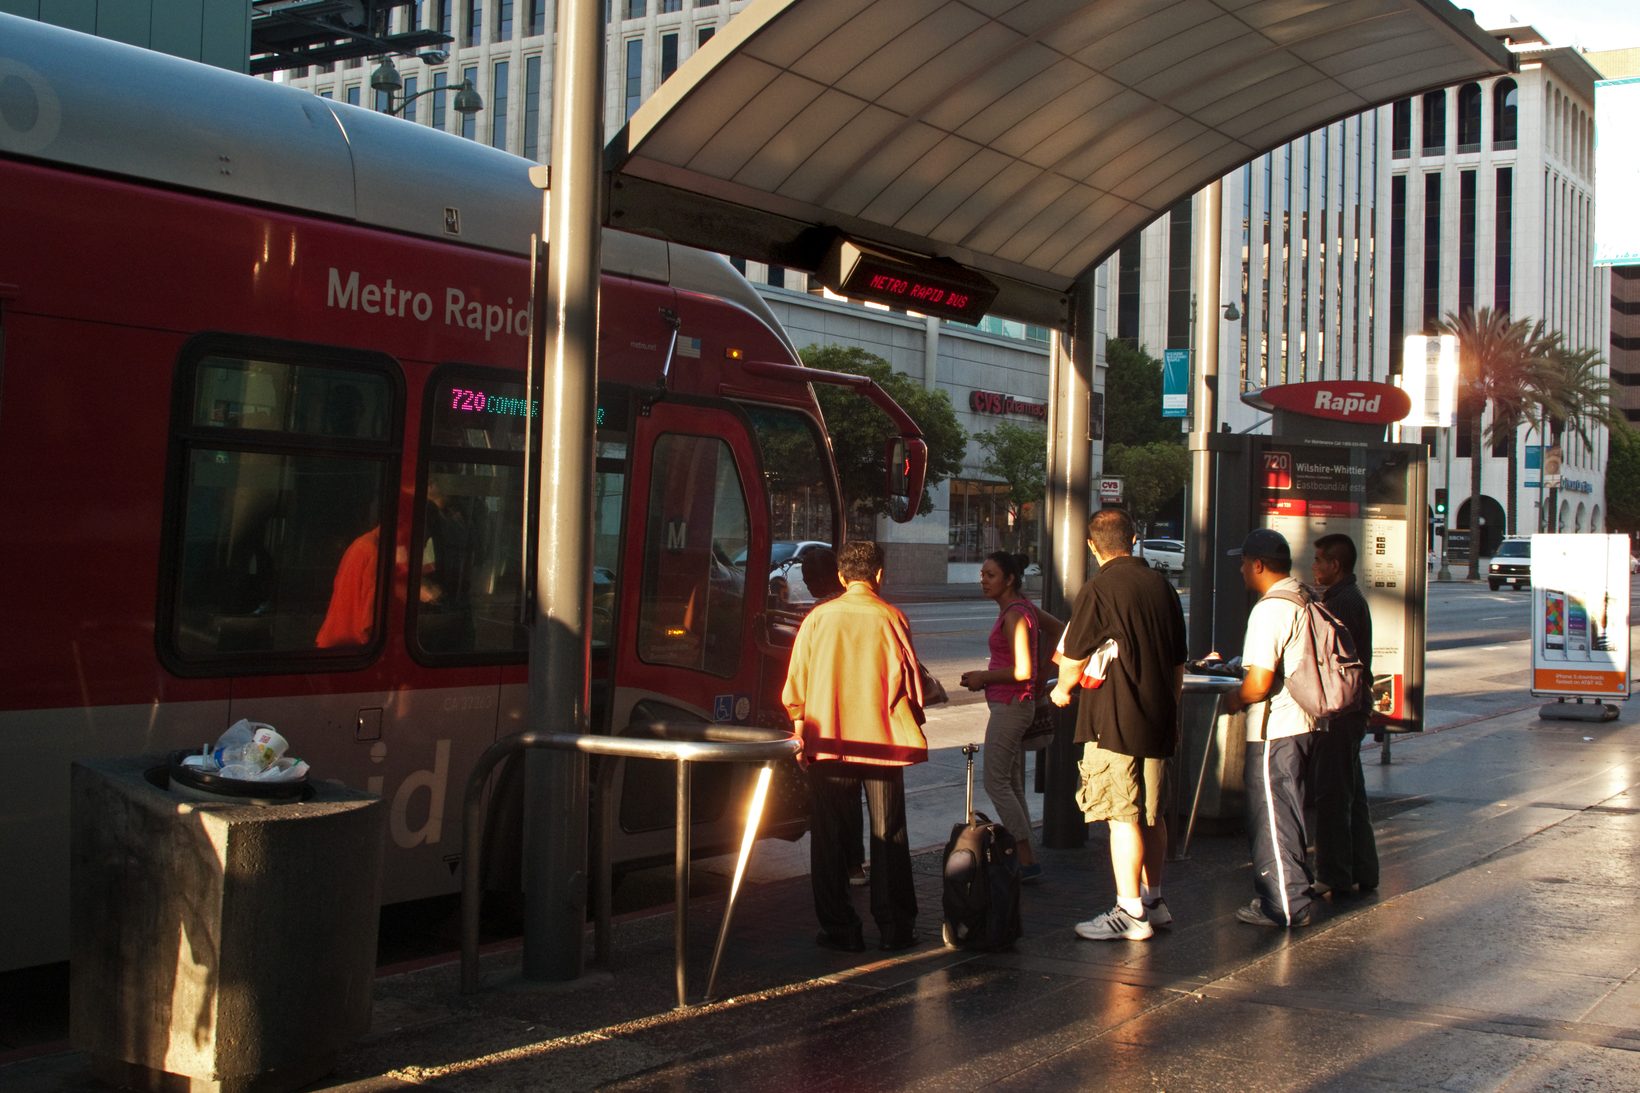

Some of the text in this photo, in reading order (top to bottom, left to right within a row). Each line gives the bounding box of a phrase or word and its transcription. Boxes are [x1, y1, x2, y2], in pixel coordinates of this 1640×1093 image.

[870, 274, 968, 308] METRO RAPID BUS
[327, 267, 531, 341] Metro Rapid
[452, 388, 486, 411] 720
[1314, 390, 1381, 415] Rapid
[1264, 454, 1366, 475] 720 Wilshire-Whittier
[1297, 480, 1366, 492] Eastbound/al este
[668, 522, 686, 549] M
